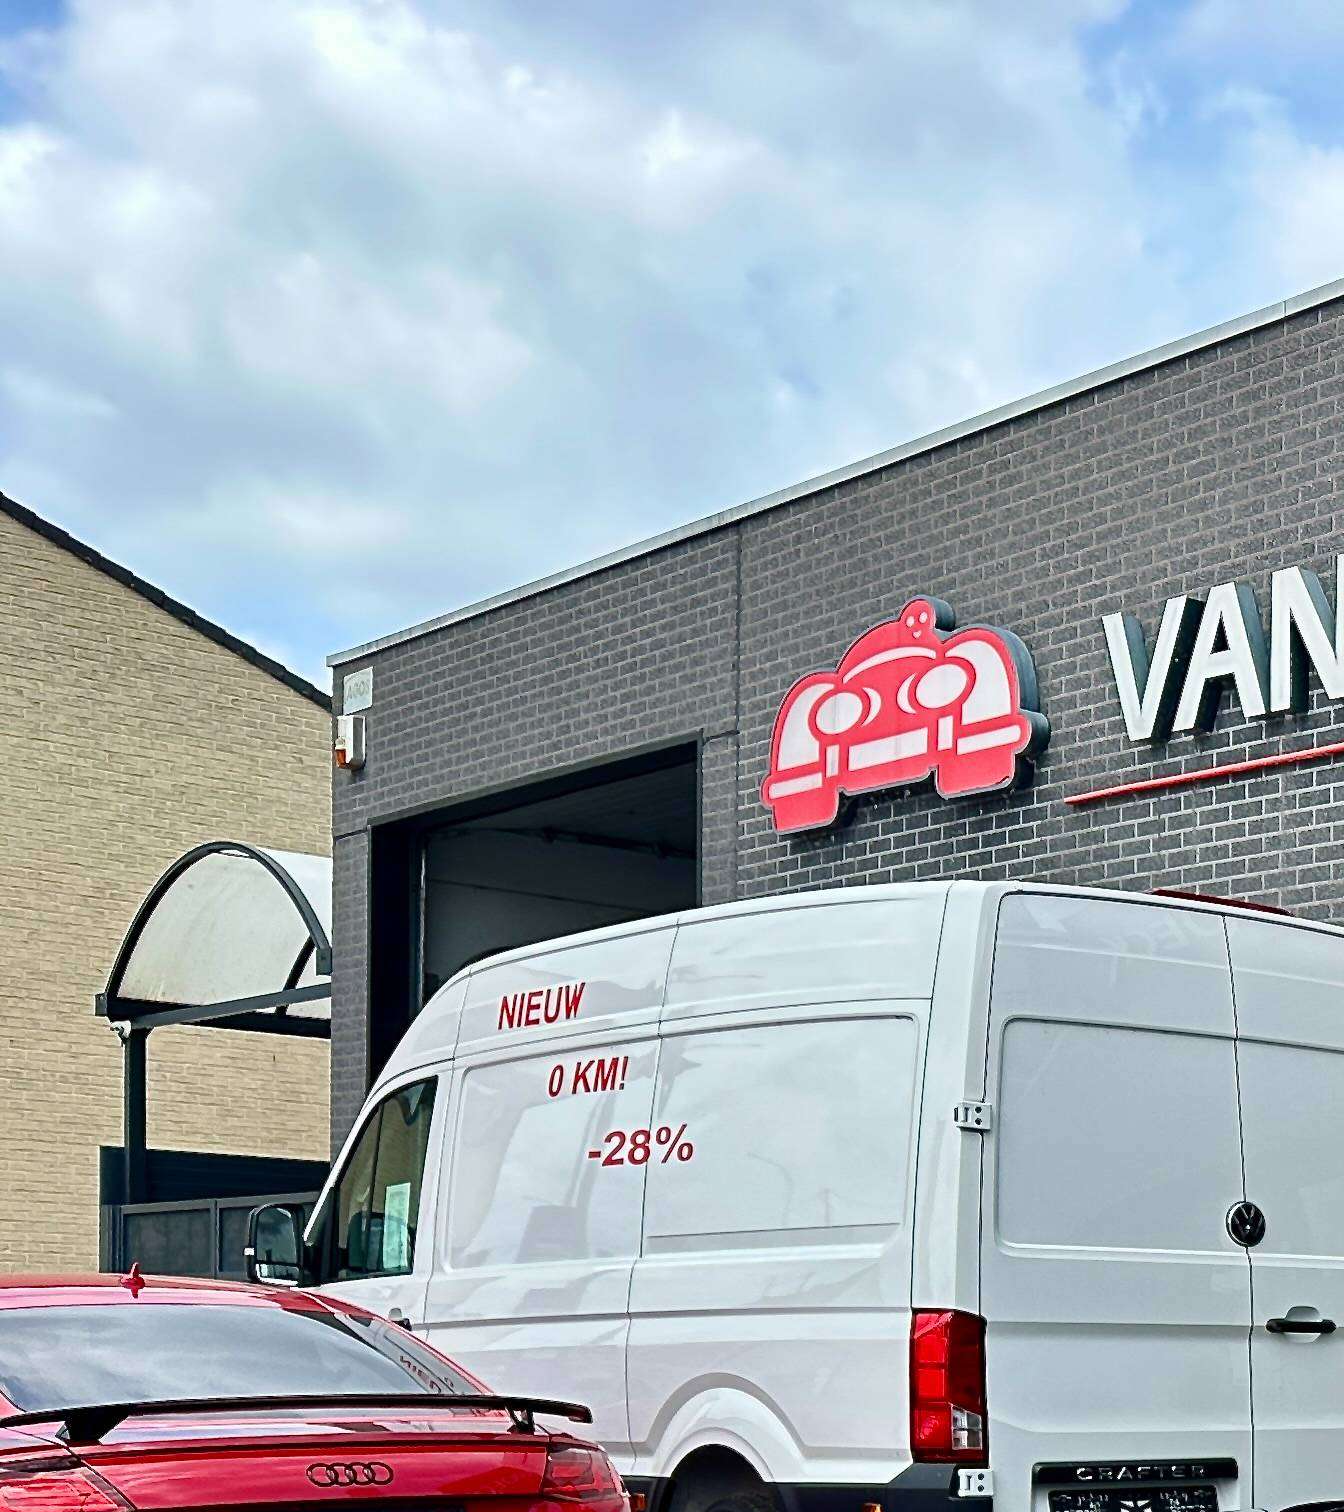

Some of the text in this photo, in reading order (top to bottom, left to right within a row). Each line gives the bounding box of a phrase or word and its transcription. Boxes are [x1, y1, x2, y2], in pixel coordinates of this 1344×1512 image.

[498, 982, 586, 1031] NIEUW
[548, 1056, 629, 1098] 0 KM!
[588, 1123, 694, 1167] -28%
[1076, 1465, 1205, 1480] CRAFTER
